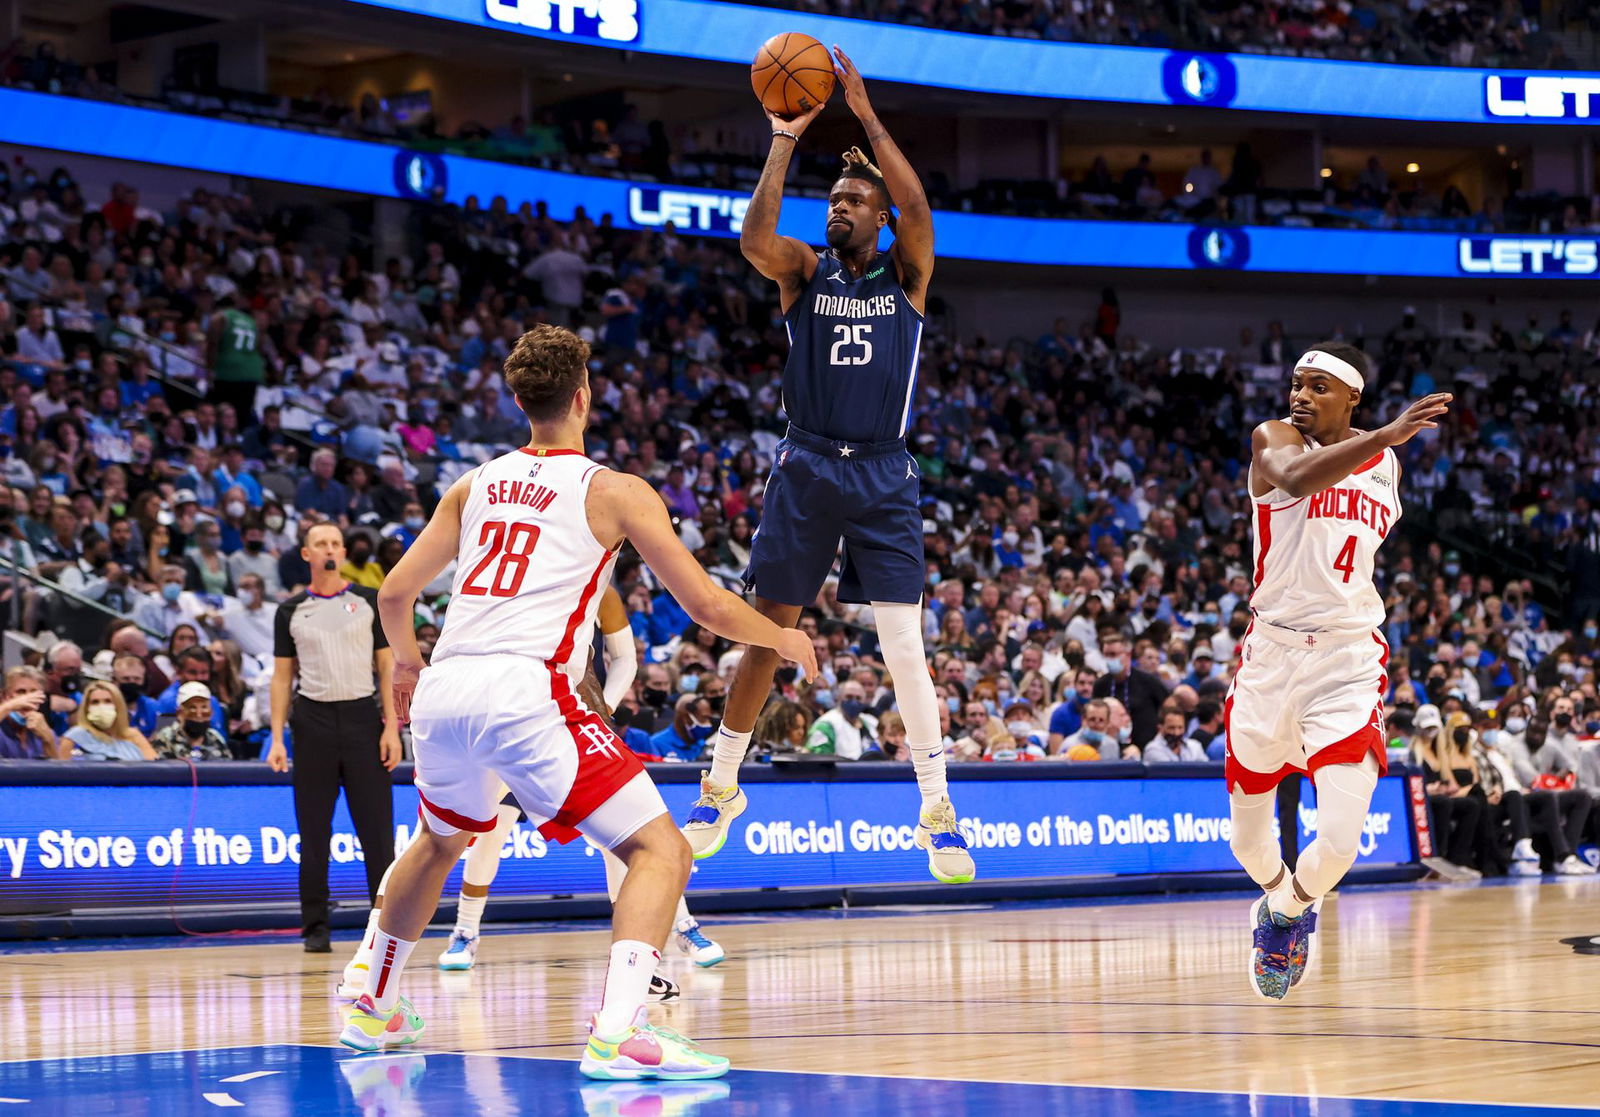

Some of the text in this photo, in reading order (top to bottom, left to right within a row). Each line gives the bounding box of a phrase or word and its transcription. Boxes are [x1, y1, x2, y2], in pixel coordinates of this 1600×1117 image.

[1460, 238, 1598, 274] LET'S
[830, 324, 873, 366] 25
[487, 480, 558, 513] SENGUN
[1371, 473, 1392, 488] MONEY
[1307, 487, 1391, 540] ROCKETS
[460, 520, 541, 598] 28
[1333, 535, 1358, 584] 4
[38, 829, 137, 869] Store
[146, 828, 184, 867] of
[192, 827, 252, 865] the
[745, 820, 845, 855] Official
[850, 819, 925, 852] Groc
[959, 816, 1022, 849] Store
[1026, 815, 1052, 847] of
[1054, 814, 1094, 847] the
[1097, 813, 1171, 845] Dallas
